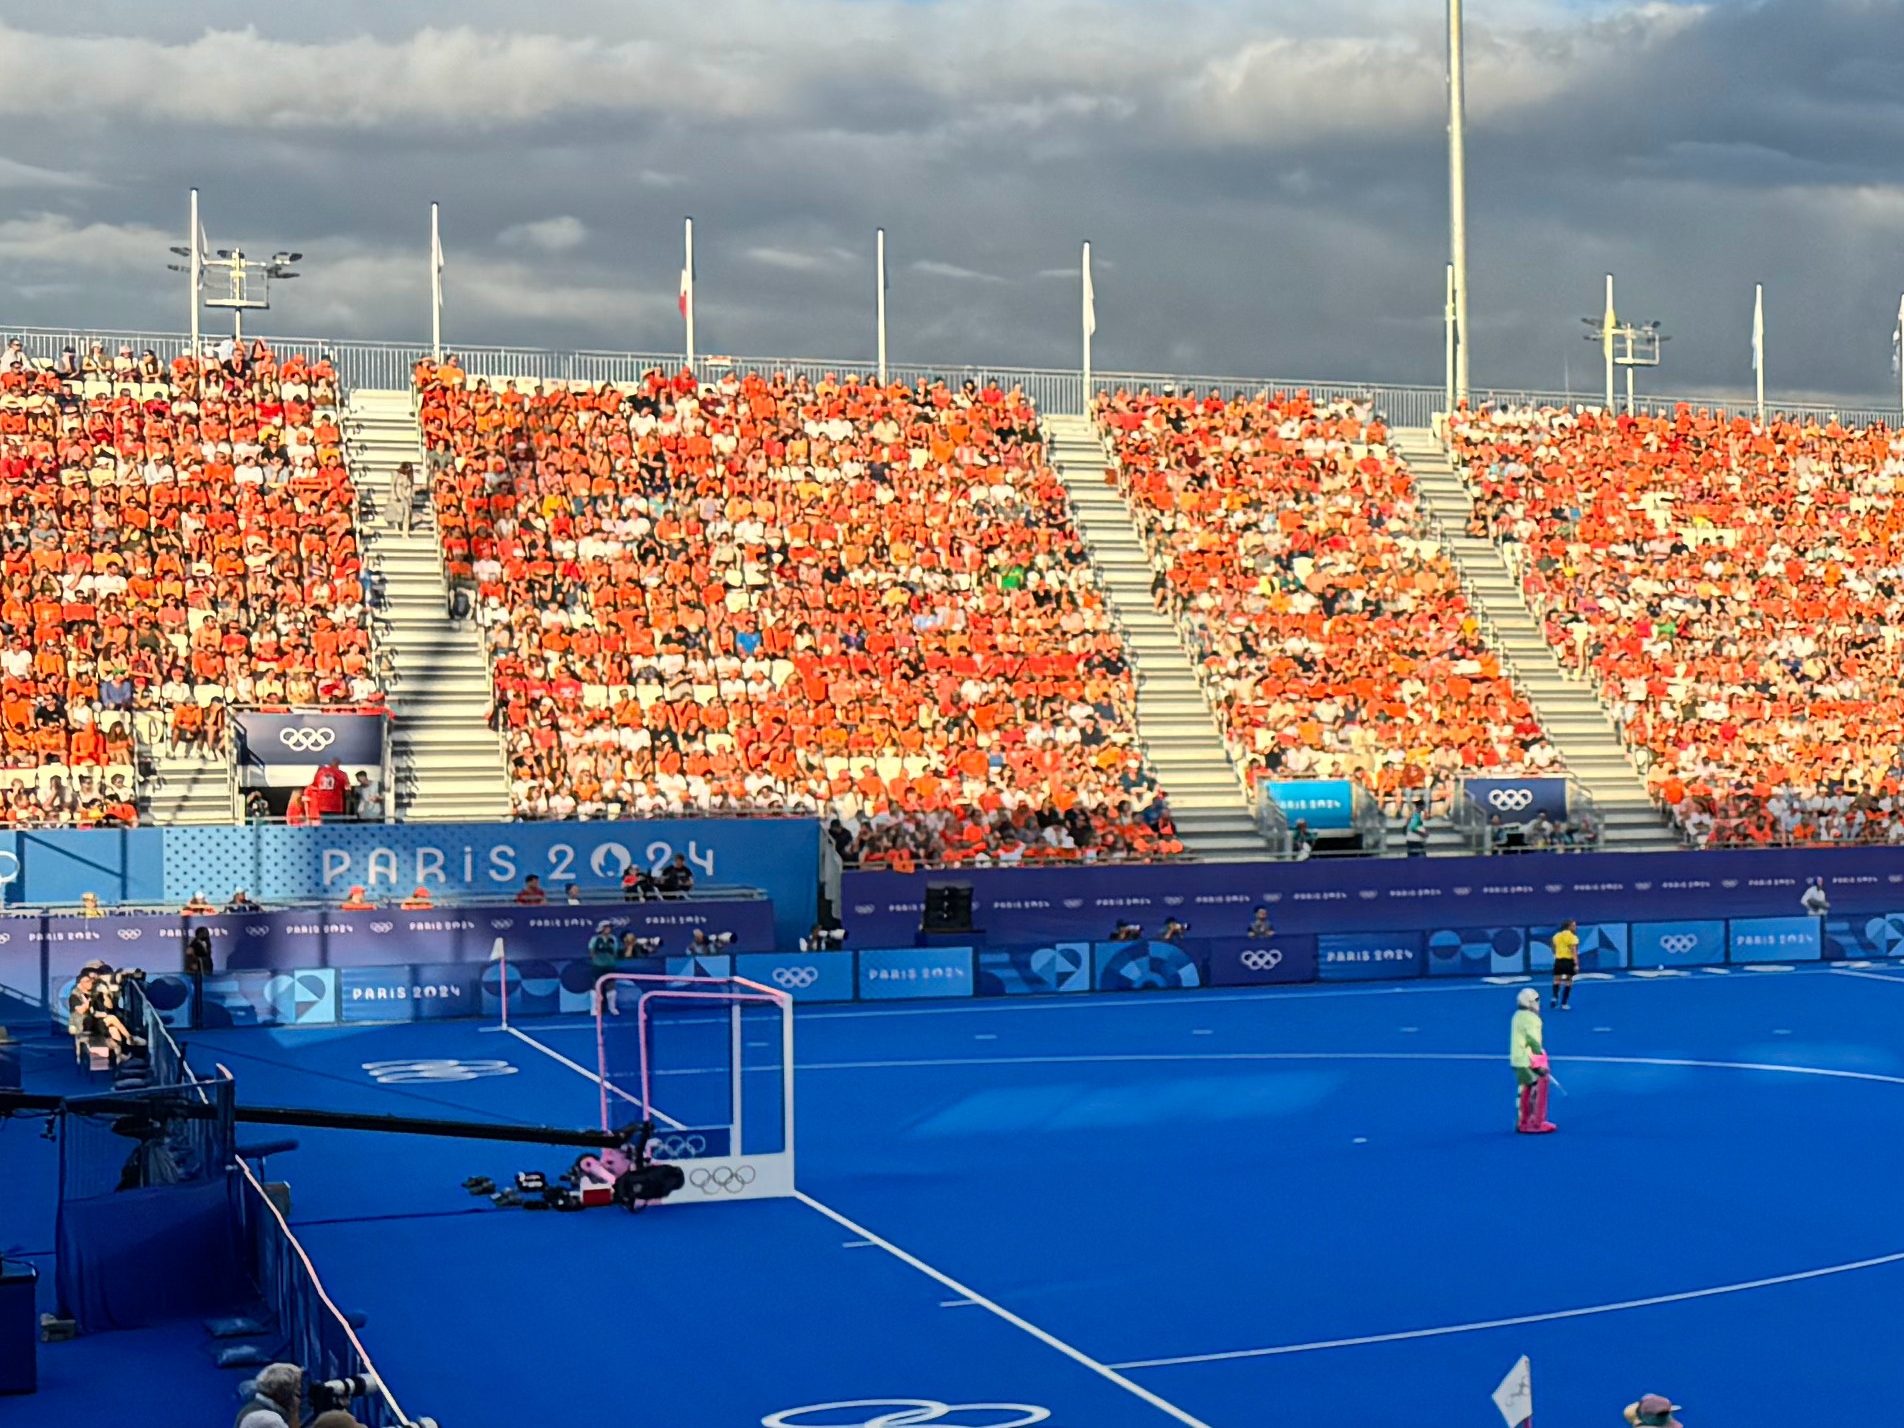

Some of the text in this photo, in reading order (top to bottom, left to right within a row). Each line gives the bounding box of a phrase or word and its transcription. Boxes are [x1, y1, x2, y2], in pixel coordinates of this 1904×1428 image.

[323, 841, 714, 885] PARIS 2024
[1327, 948, 1414, 962] PARIS 2024
[869, 966, 964, 981] PARIS 2024
[352, 984, 461, 1001] PARIS 2024
